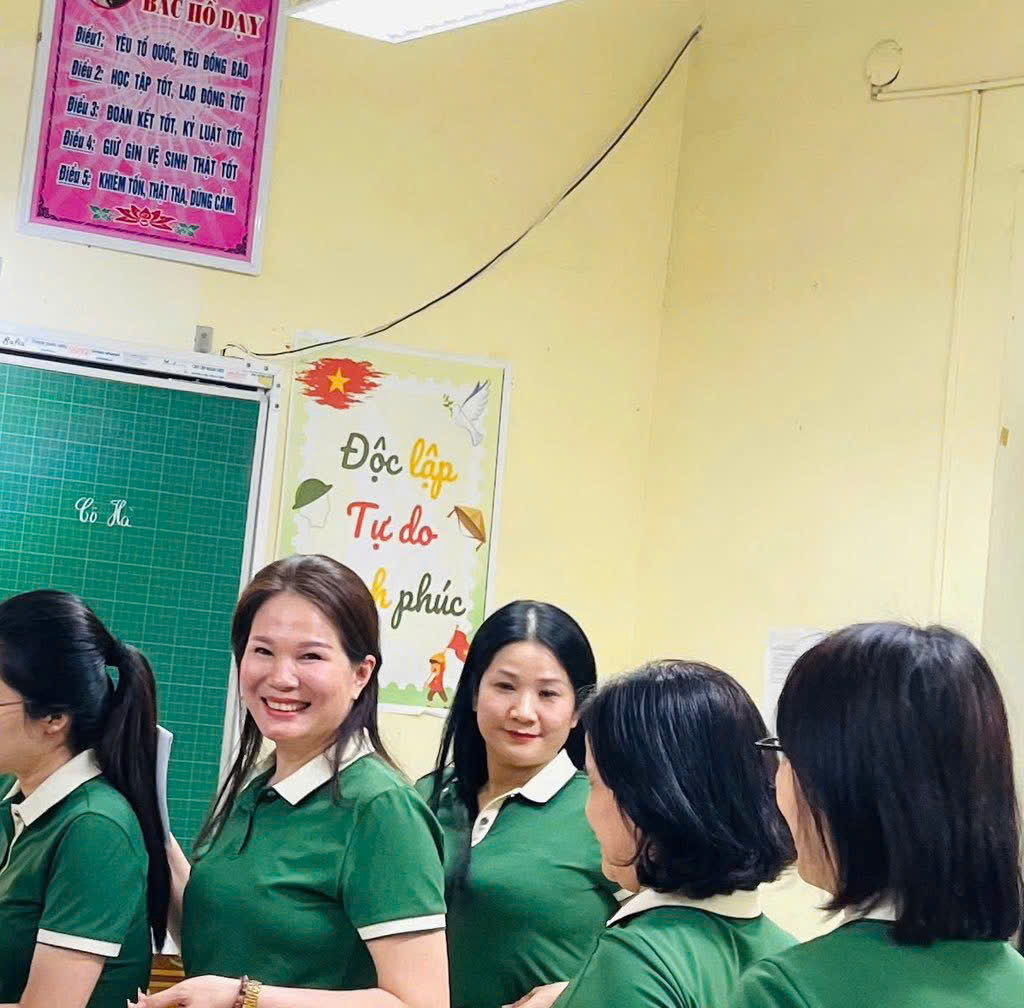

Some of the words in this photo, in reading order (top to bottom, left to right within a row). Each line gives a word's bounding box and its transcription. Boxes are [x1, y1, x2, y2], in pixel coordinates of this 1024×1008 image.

[220, 9, 264, 40] DẠY
[111, 68, 130, 89] HỌC
[134, 72, 152, 94] TẬP
[179, 83, 196, 102] LAO
[164, 151, 188, 170] SINH
[340, 432, 403, 483] Độc
[409, 437, 458, 501] lập
[347, 501, 393, 551] Tự
[399, 505, 439, 547] do
[391, 573, 467, 630] phúc
